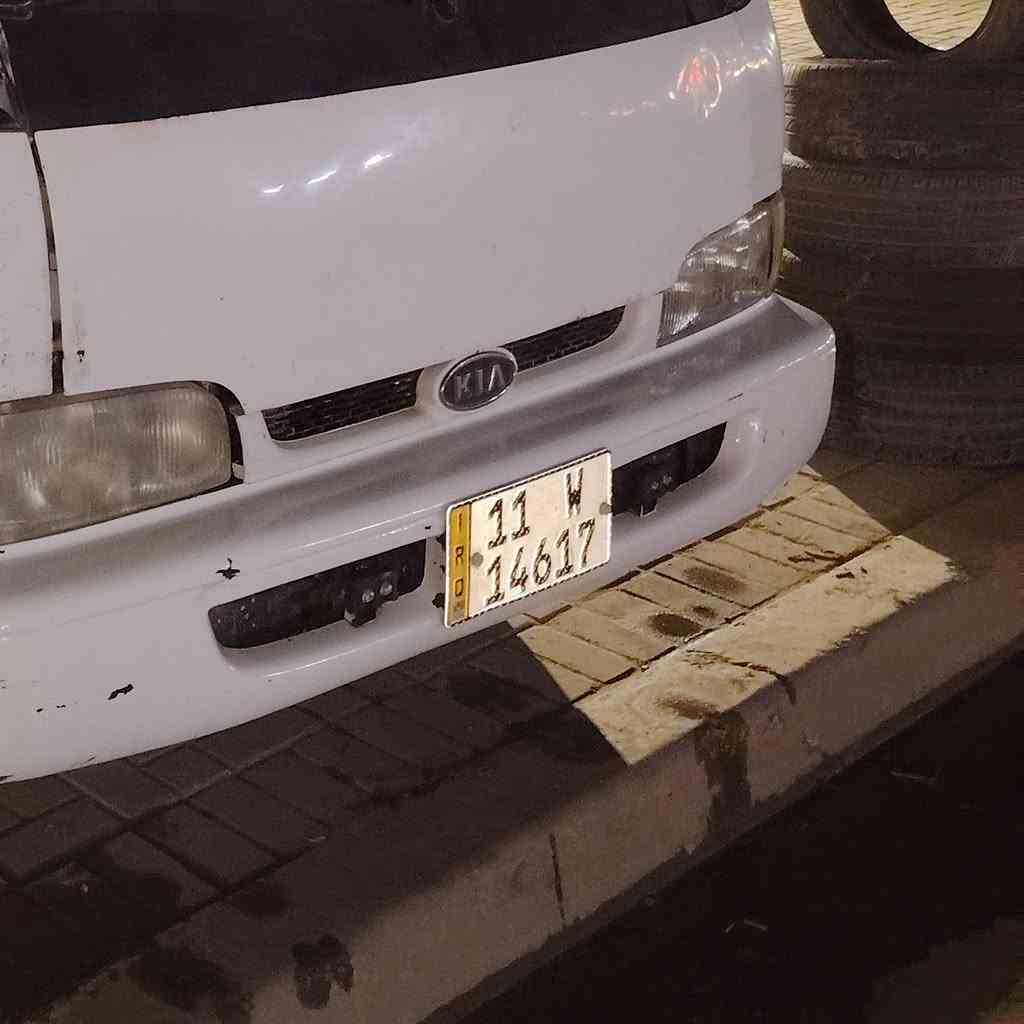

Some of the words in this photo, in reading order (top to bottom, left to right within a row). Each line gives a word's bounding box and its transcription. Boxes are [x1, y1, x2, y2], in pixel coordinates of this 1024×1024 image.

[453, 363, 508, 401] KIA
[487, 489, 531, 550] 11
[564, 467, 584, 519] W
[484, 517, 597, 606] 14617
